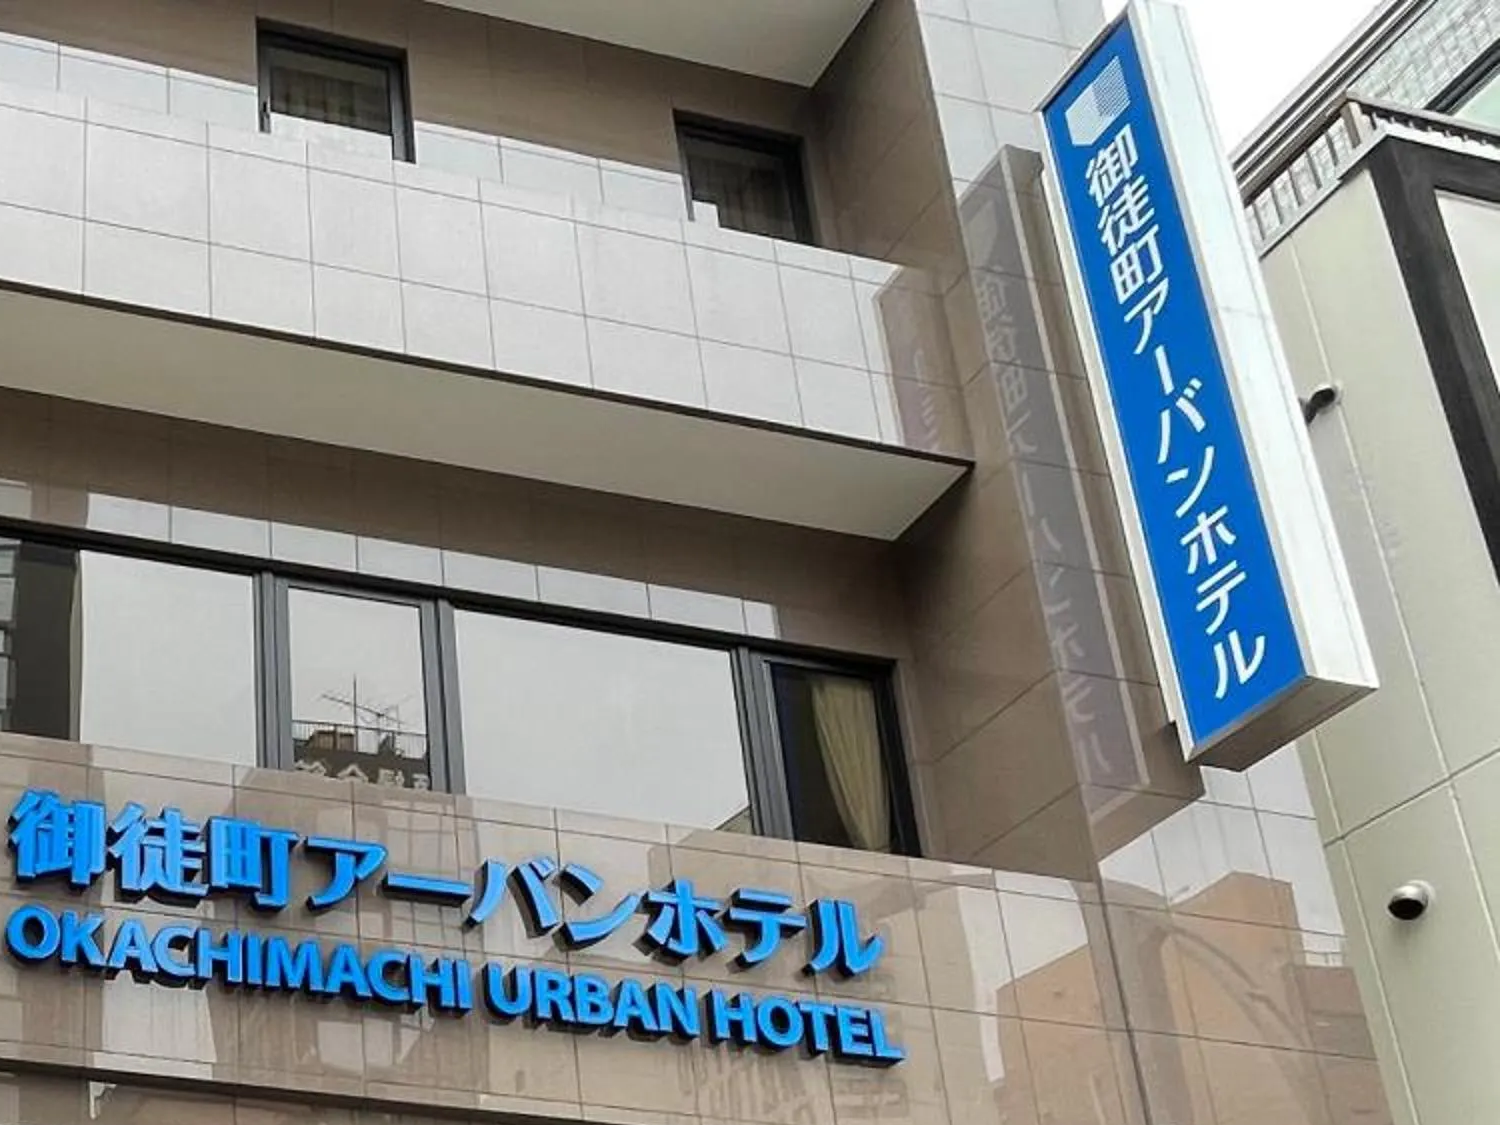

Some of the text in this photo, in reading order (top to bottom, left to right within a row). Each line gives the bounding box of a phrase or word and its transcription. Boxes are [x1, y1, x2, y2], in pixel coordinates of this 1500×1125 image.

[1082, 122, 1267, 700] 御徒町アーバンホテル
[7, 789, 884, 977] 御徒町アーバンホテル
[5, 904, 909, 1068] OKACHIMACHI URBAN HOTEL
